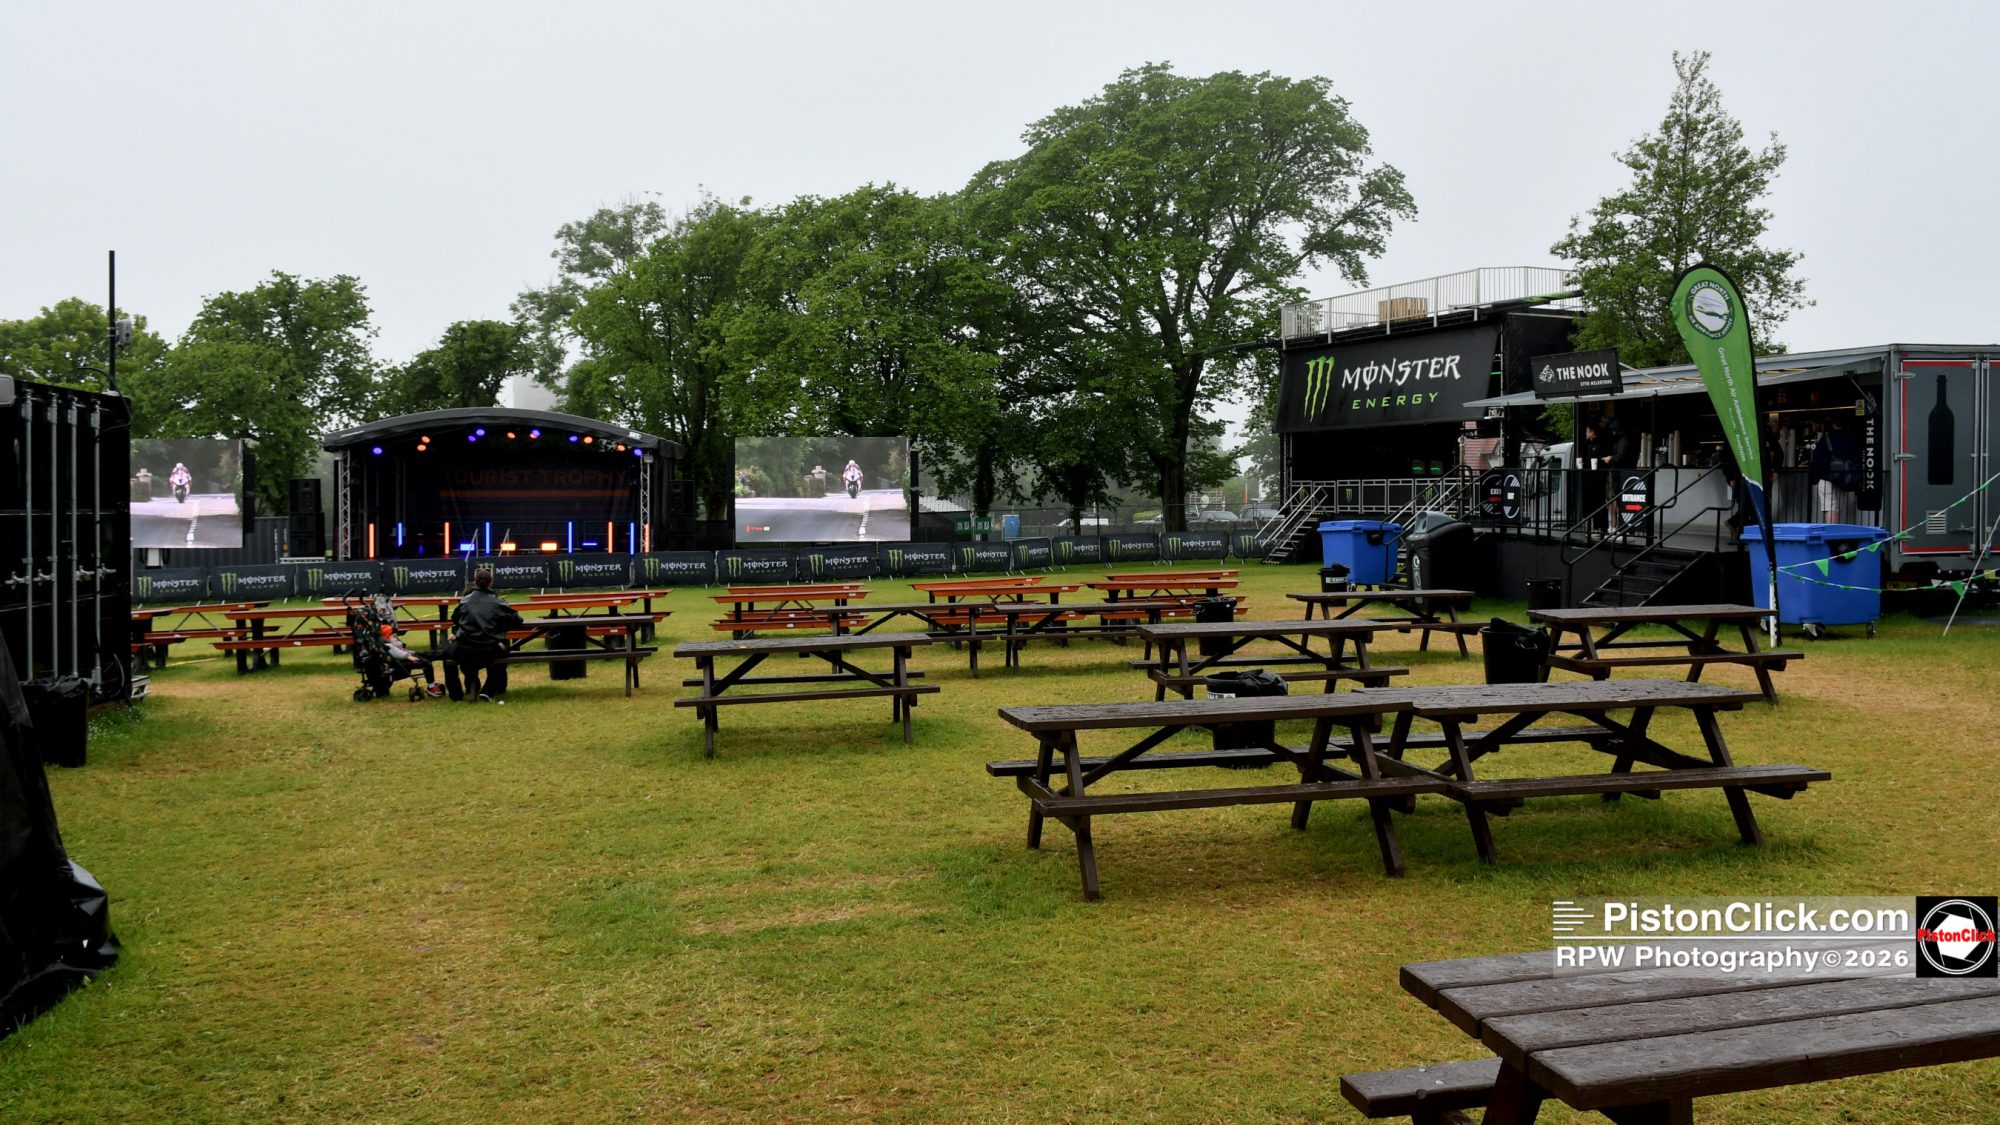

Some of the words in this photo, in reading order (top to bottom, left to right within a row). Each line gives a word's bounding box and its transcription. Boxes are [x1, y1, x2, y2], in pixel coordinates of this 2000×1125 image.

[1691, 282, 1708, 294] GREAT
[1710, 282, 1730, 300] NORTH
[1342, 355, 1461, 391] MONSTER
[1556, 367, 1576, 381] THE
[1577, 363, 1609, 379] NOOK
[1724, 366, 1733, 386] North
[1352, 392, 1439, 409] ENERGY
[1866, 419, 1874, 444] THE
[1866, 448, 1874, 489] NOOK
[541, 470, 627, 484] TROPHY
[1622, 494, 1646, 502] ENTRANCE
[825, 556, 868, 565] MONSTER
[904, 553, 946, 561] MONSTER
[575, 564, 622, 572] MONSTER
[661, 562, 706, 570] MONSTER
[744, 560, 788, 568] MONSTER
[409, 570, 456, 578] MONSTER
[496, 566, 543, 575] MONSTER
[238, 575, 286, 584] MONSTER
[324, 572, 372, 580] MONSTER
[152, 579, 199, 588] MONSTER
